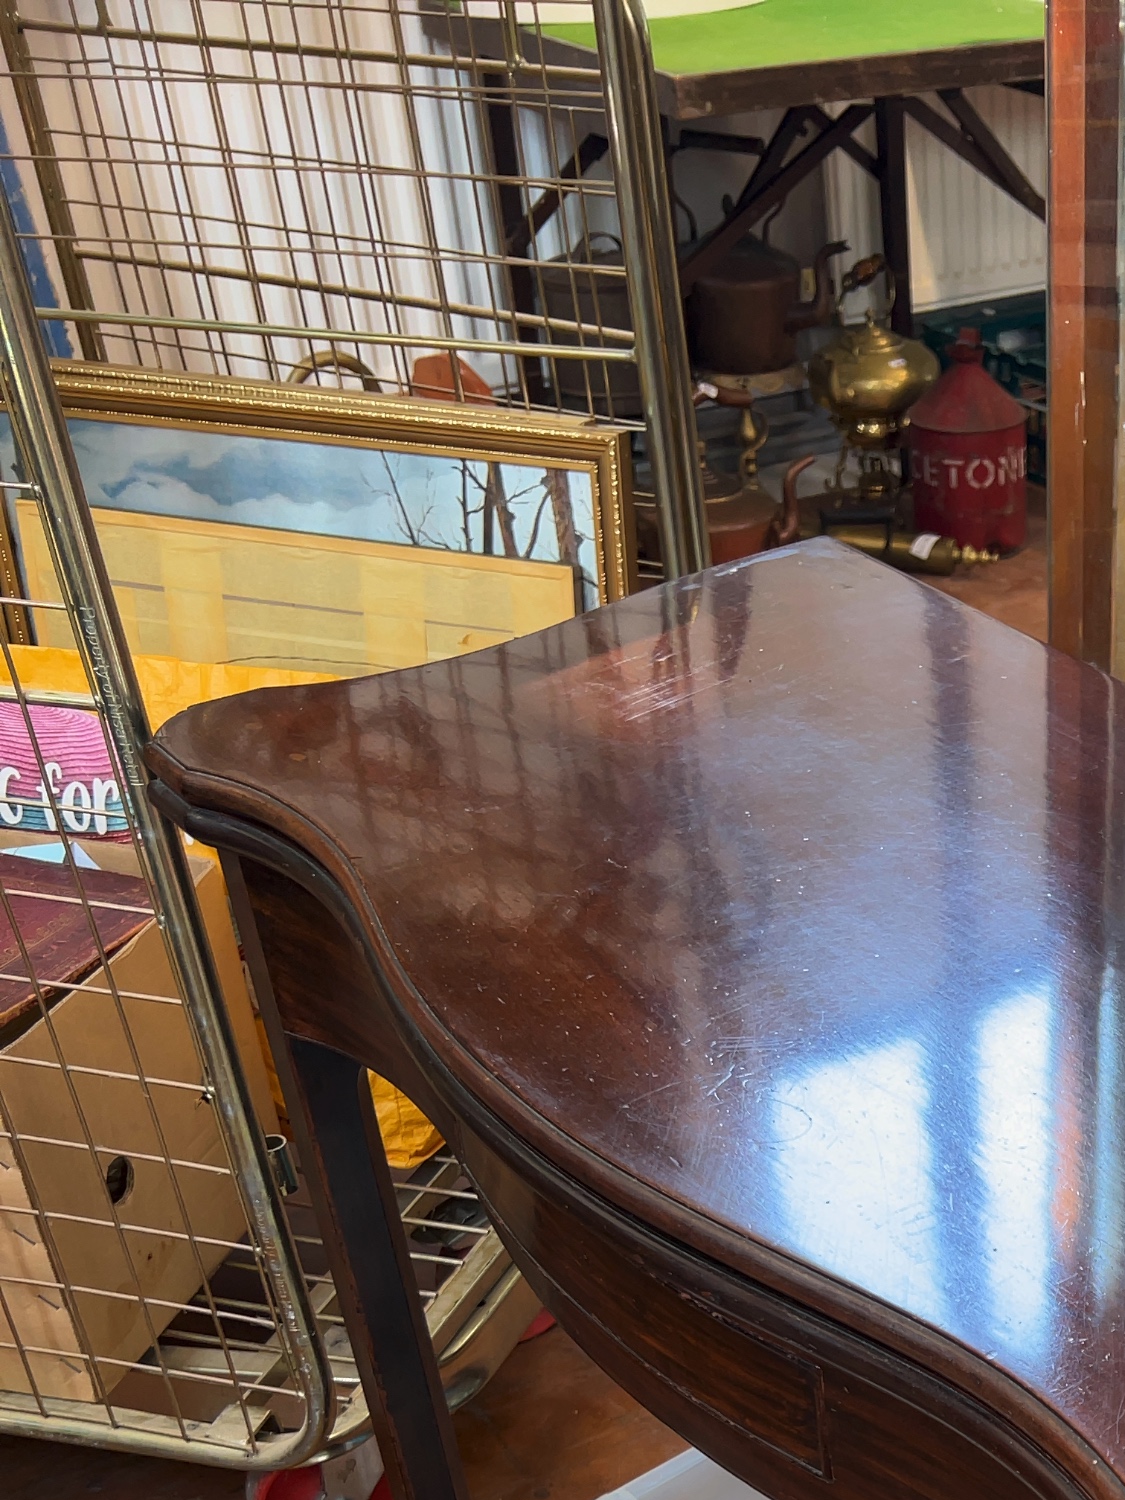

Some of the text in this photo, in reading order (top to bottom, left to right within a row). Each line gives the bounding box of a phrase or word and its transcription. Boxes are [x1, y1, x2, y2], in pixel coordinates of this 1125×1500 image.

[79, 606, 110, 679] Property
[103, 682, 119, 702] of
[119, 742, 145, 787] Retail
[36, 762, 121, 835] for
